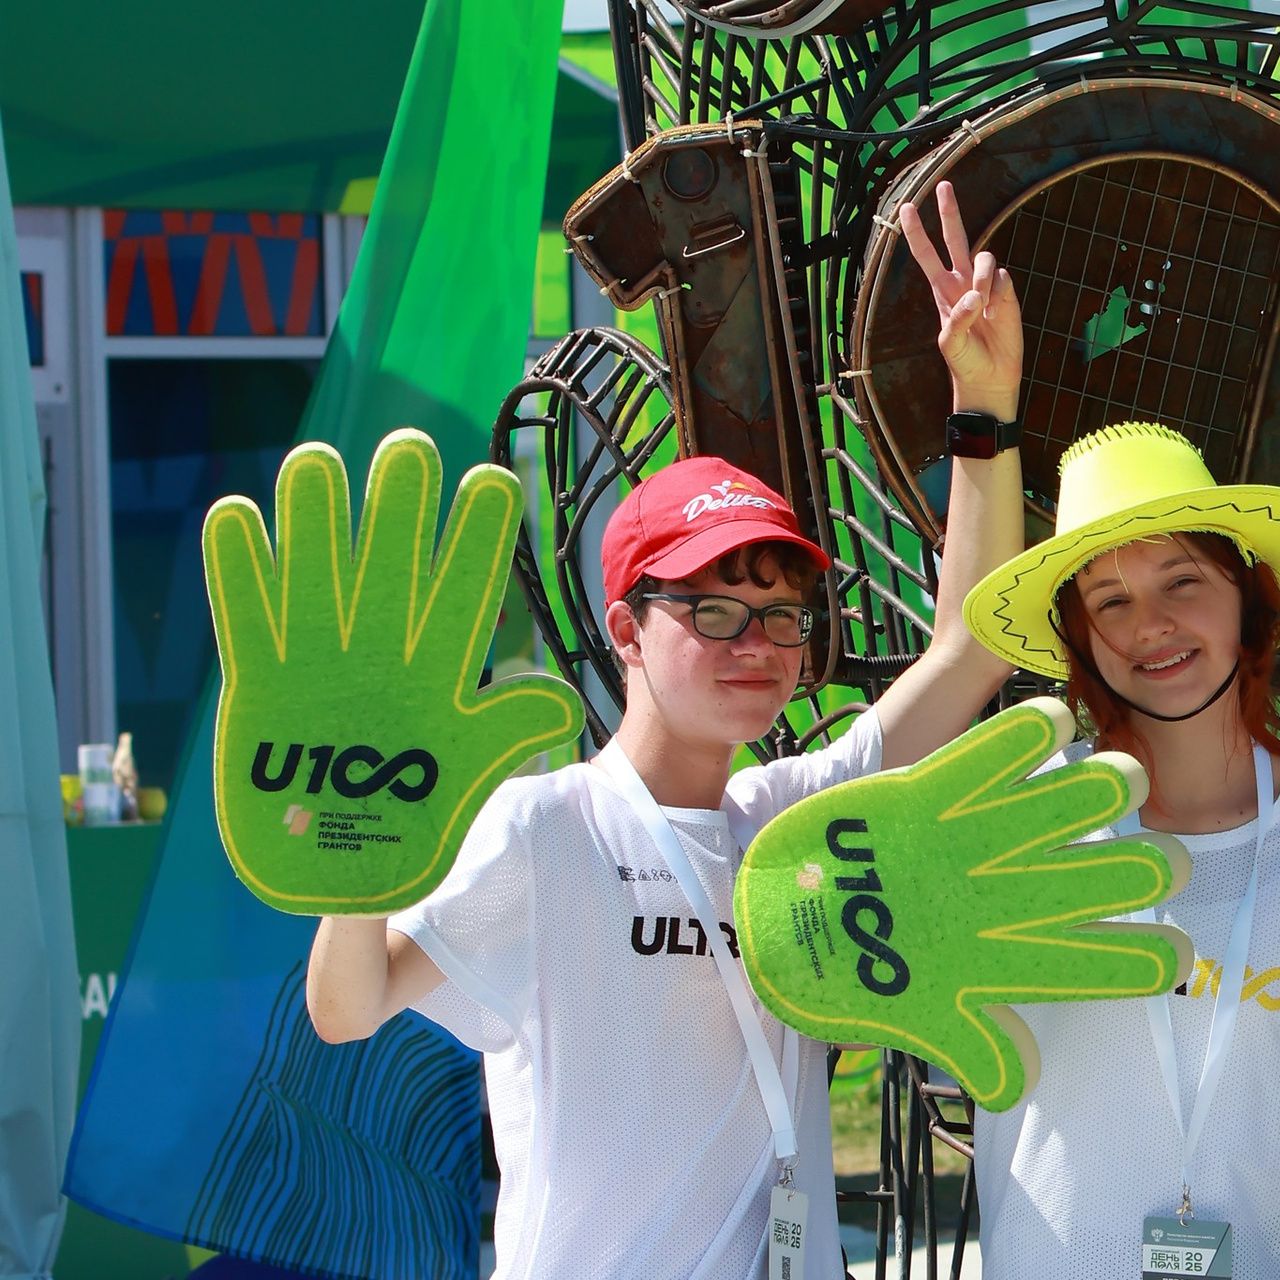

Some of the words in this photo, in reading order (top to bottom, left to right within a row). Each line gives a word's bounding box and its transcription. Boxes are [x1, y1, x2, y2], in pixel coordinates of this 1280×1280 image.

[318, 821, 355, 830] ФОНДА
[318, 831, 402, 843] ПРЕЗИДЕНТСКИХ
[317, 842, 362, 851] ГРАНТОВ
[792, 1223, 801, 1235] 20
[791, 1236, 800, 1248] 25
[1151, 1252, 1180, 1262] ДЕНЬ
[1185, 1252, 1203, 1261] 20
[1185, 1262, 1203, 1271] 25
